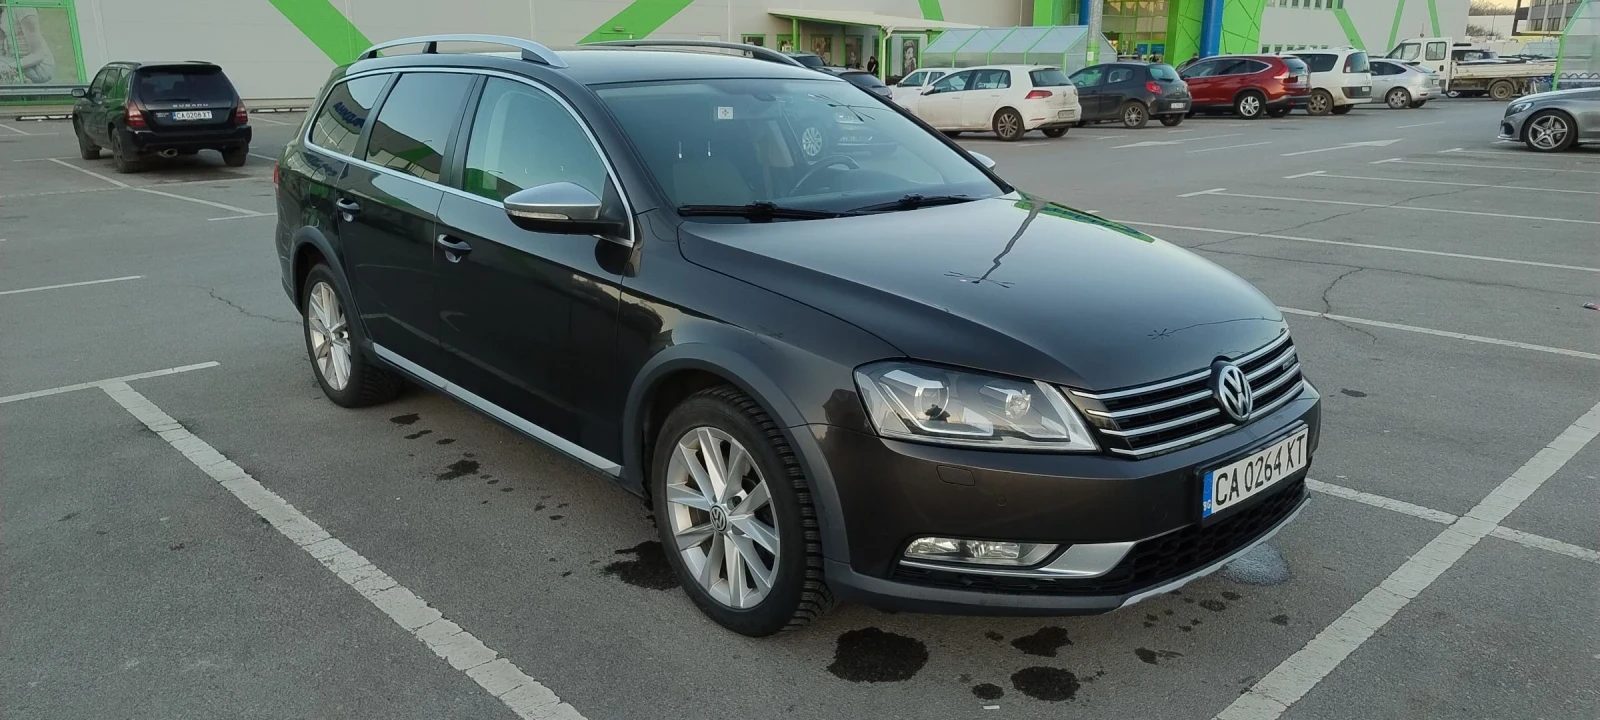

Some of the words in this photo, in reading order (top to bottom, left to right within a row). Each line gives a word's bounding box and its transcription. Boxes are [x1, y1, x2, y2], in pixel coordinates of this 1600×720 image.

[1215, 467, 1240, 506] CA
[1245, 446, 1283, 493] 0264
[1286, 433, 1306, 472] XT
